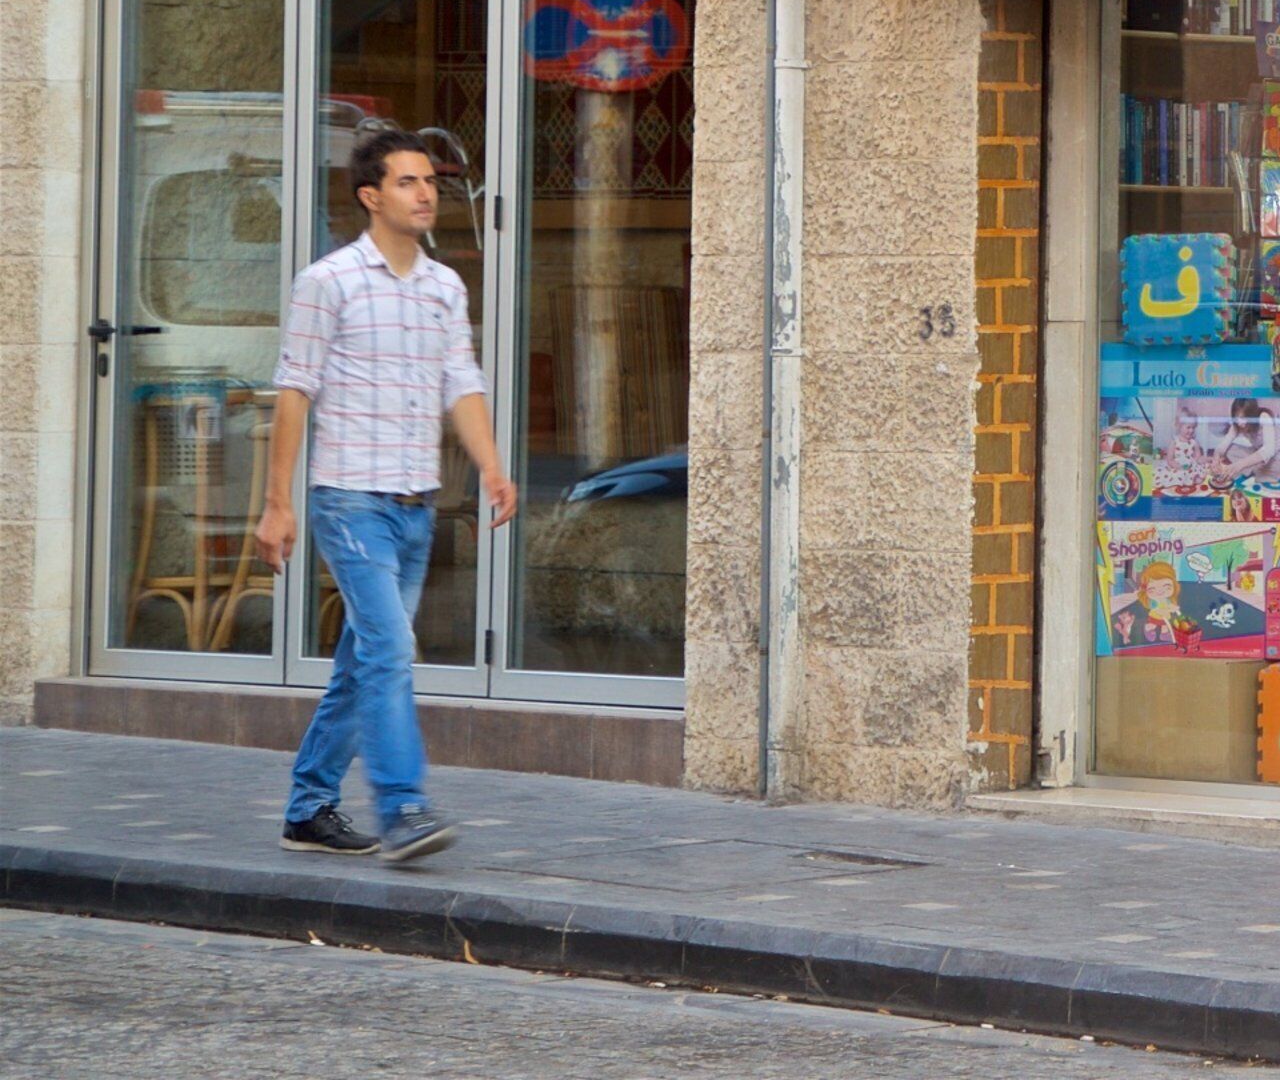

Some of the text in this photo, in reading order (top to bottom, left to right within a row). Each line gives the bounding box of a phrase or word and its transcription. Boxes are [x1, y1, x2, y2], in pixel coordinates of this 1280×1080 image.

[1140, 246, 1200, 317] ف
[1132, 361, 1186, 387] Ludo
[1108, 538, 1185, 557] Shopping
